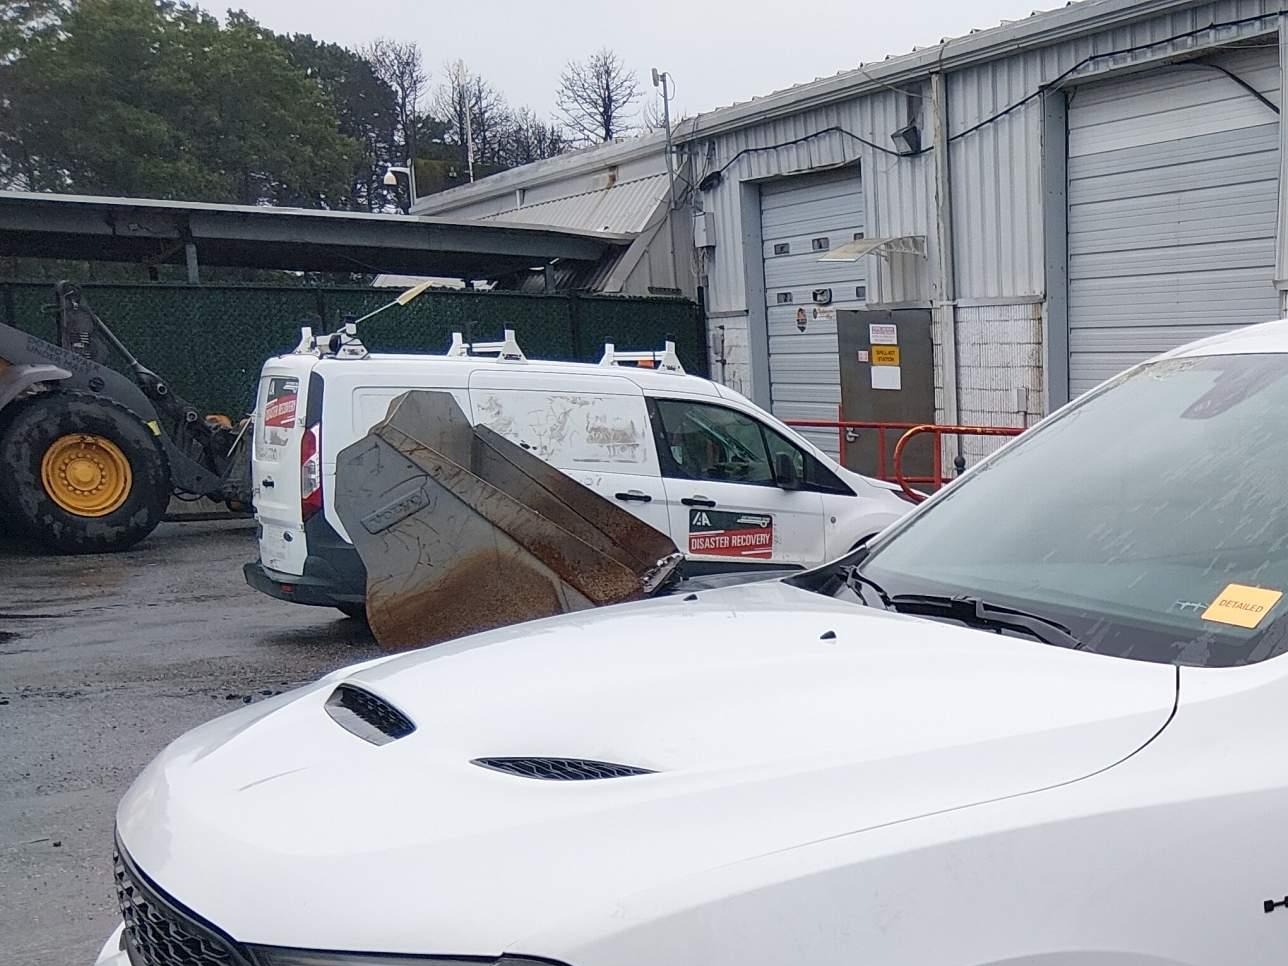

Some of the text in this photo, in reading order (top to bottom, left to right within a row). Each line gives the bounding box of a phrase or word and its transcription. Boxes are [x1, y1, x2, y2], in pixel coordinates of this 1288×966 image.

[691, 534, 769, 550] DISASTER RECOVERY
[1219, 600, 1264, 613] DETAILED
